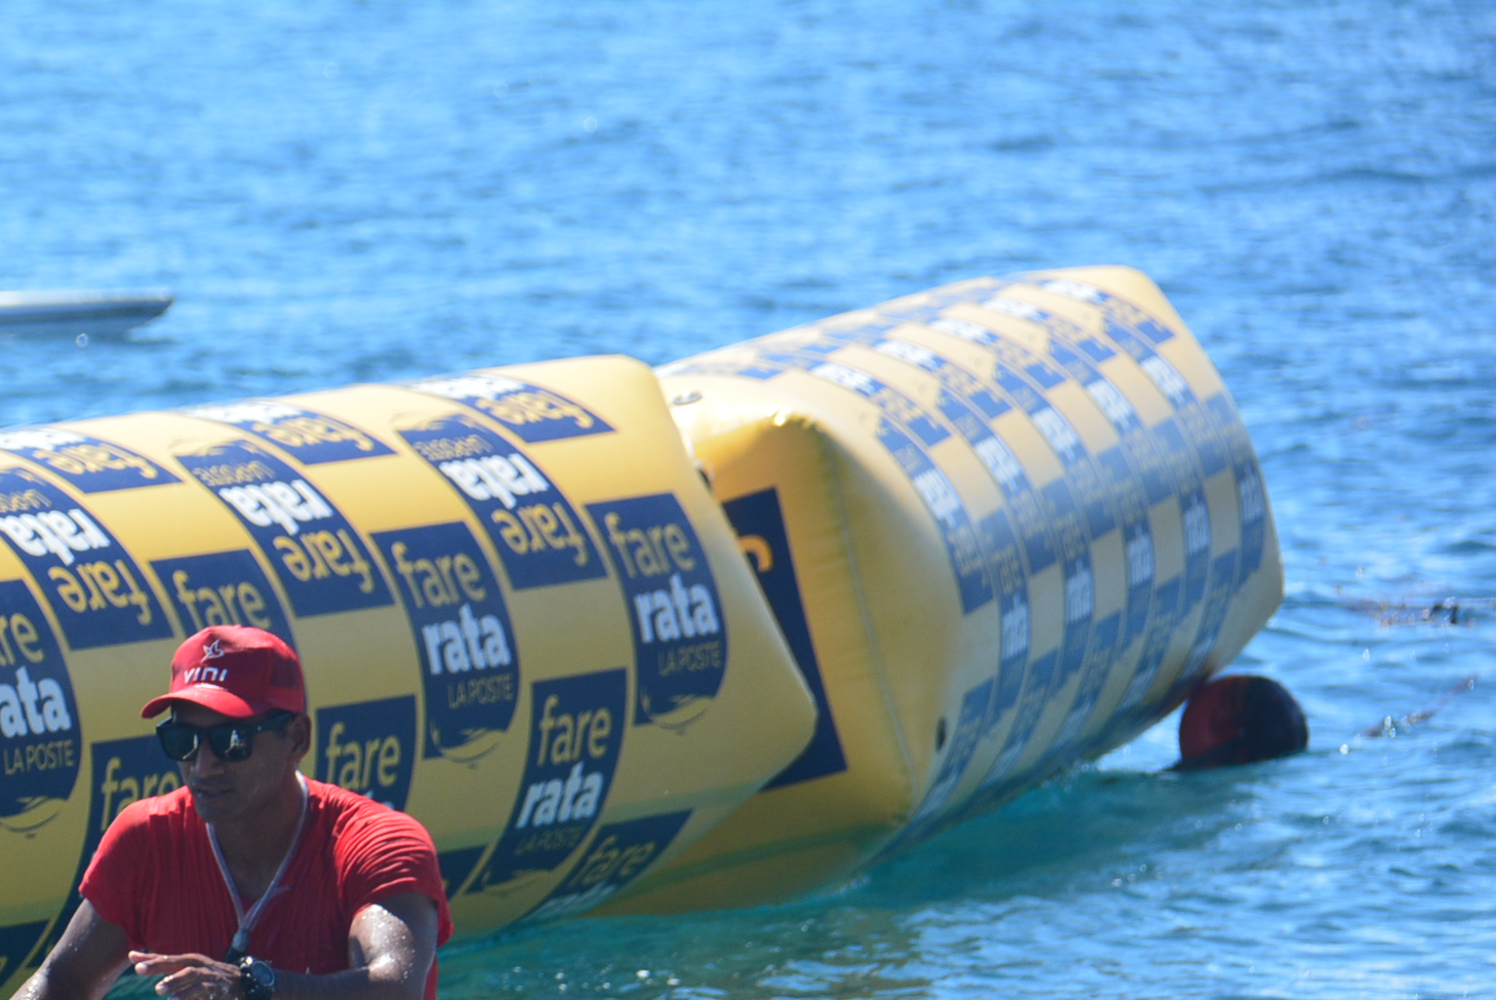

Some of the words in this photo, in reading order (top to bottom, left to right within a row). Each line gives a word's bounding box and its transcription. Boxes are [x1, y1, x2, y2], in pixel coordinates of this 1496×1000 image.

[218, 479, 333, 536] rata
[439, 453, 550, 509] rata
[273, 529, 375, 593] fare
[491, 502, 589, 567] fare
[605, 512, 695, 579] fare
[48, 560, 153, 626] fare
[171, 570, 270, 629] fare
[391, 541, 487, 609] fare
[421, 603, 511, 675] rata
[633, 573, 719, 644] rata
[5, 745, 25, 775] LA
[26, 739, 75, 770] POSTE
[325, 722, 401, 791] fare
[538, 695, 613, 766] fare
[516, 762, 604, 830] rata
